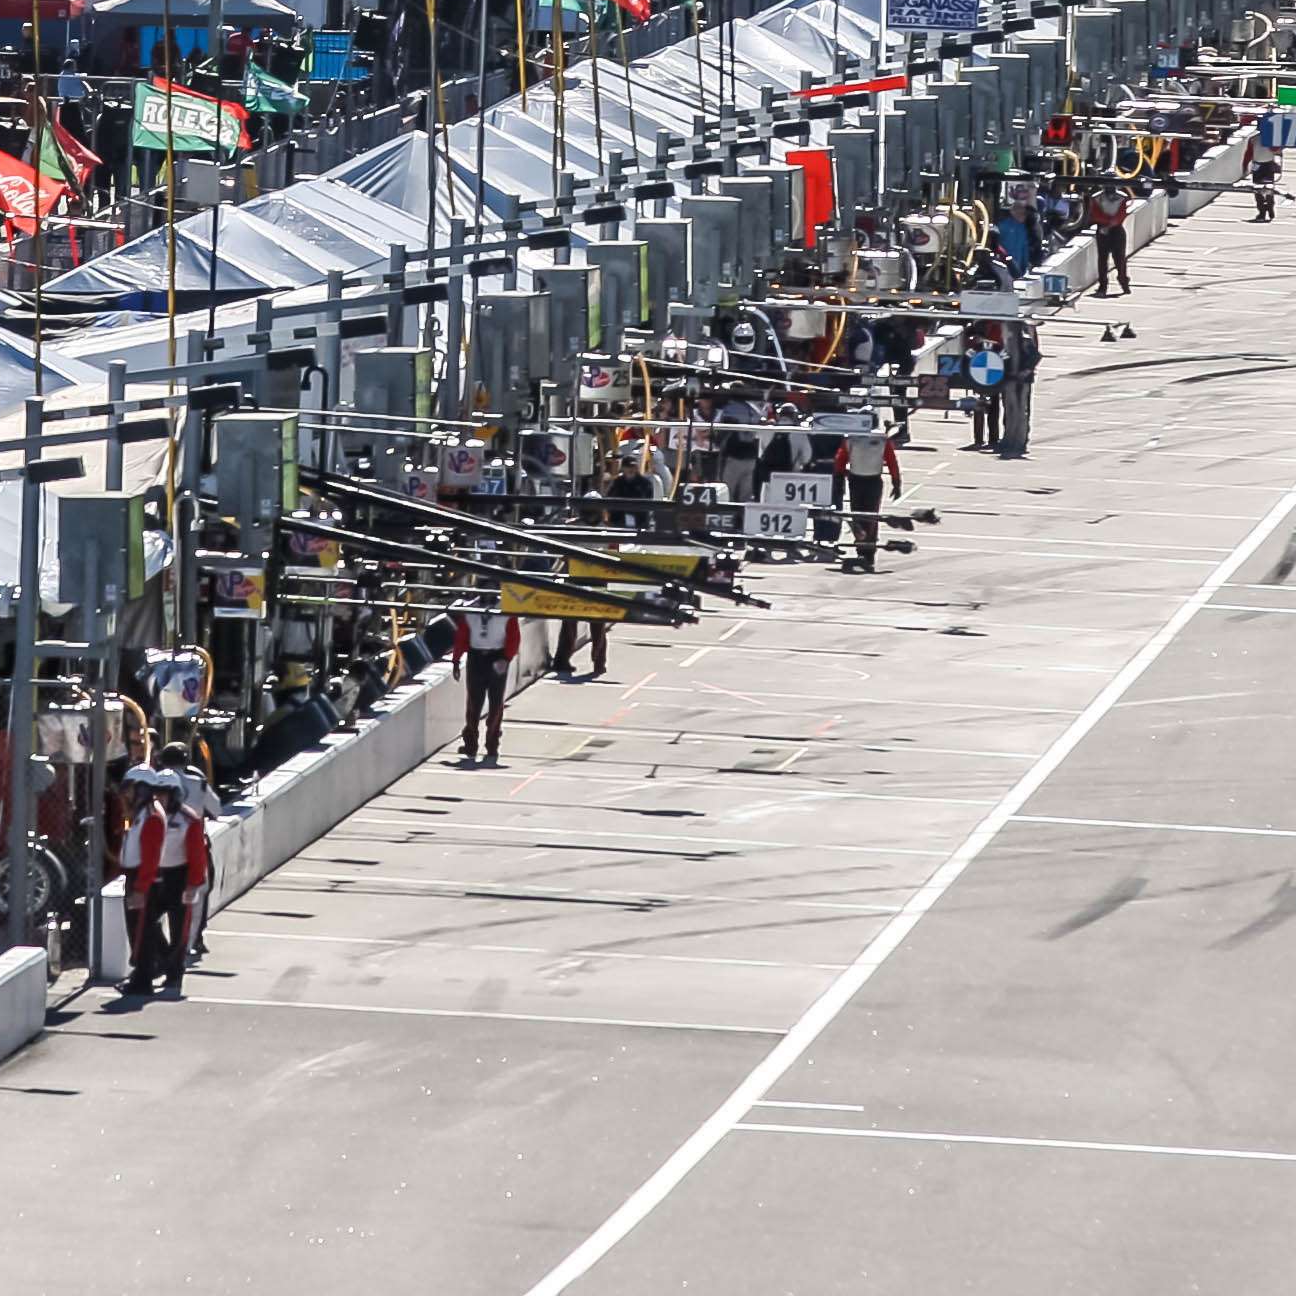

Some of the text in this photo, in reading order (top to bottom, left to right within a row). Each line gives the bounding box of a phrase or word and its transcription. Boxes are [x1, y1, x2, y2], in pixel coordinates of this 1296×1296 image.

[142, 105, 210, 131] ROLEX
[785, 483, 818, 502] 911
[760, 513, 793, 533] 912
